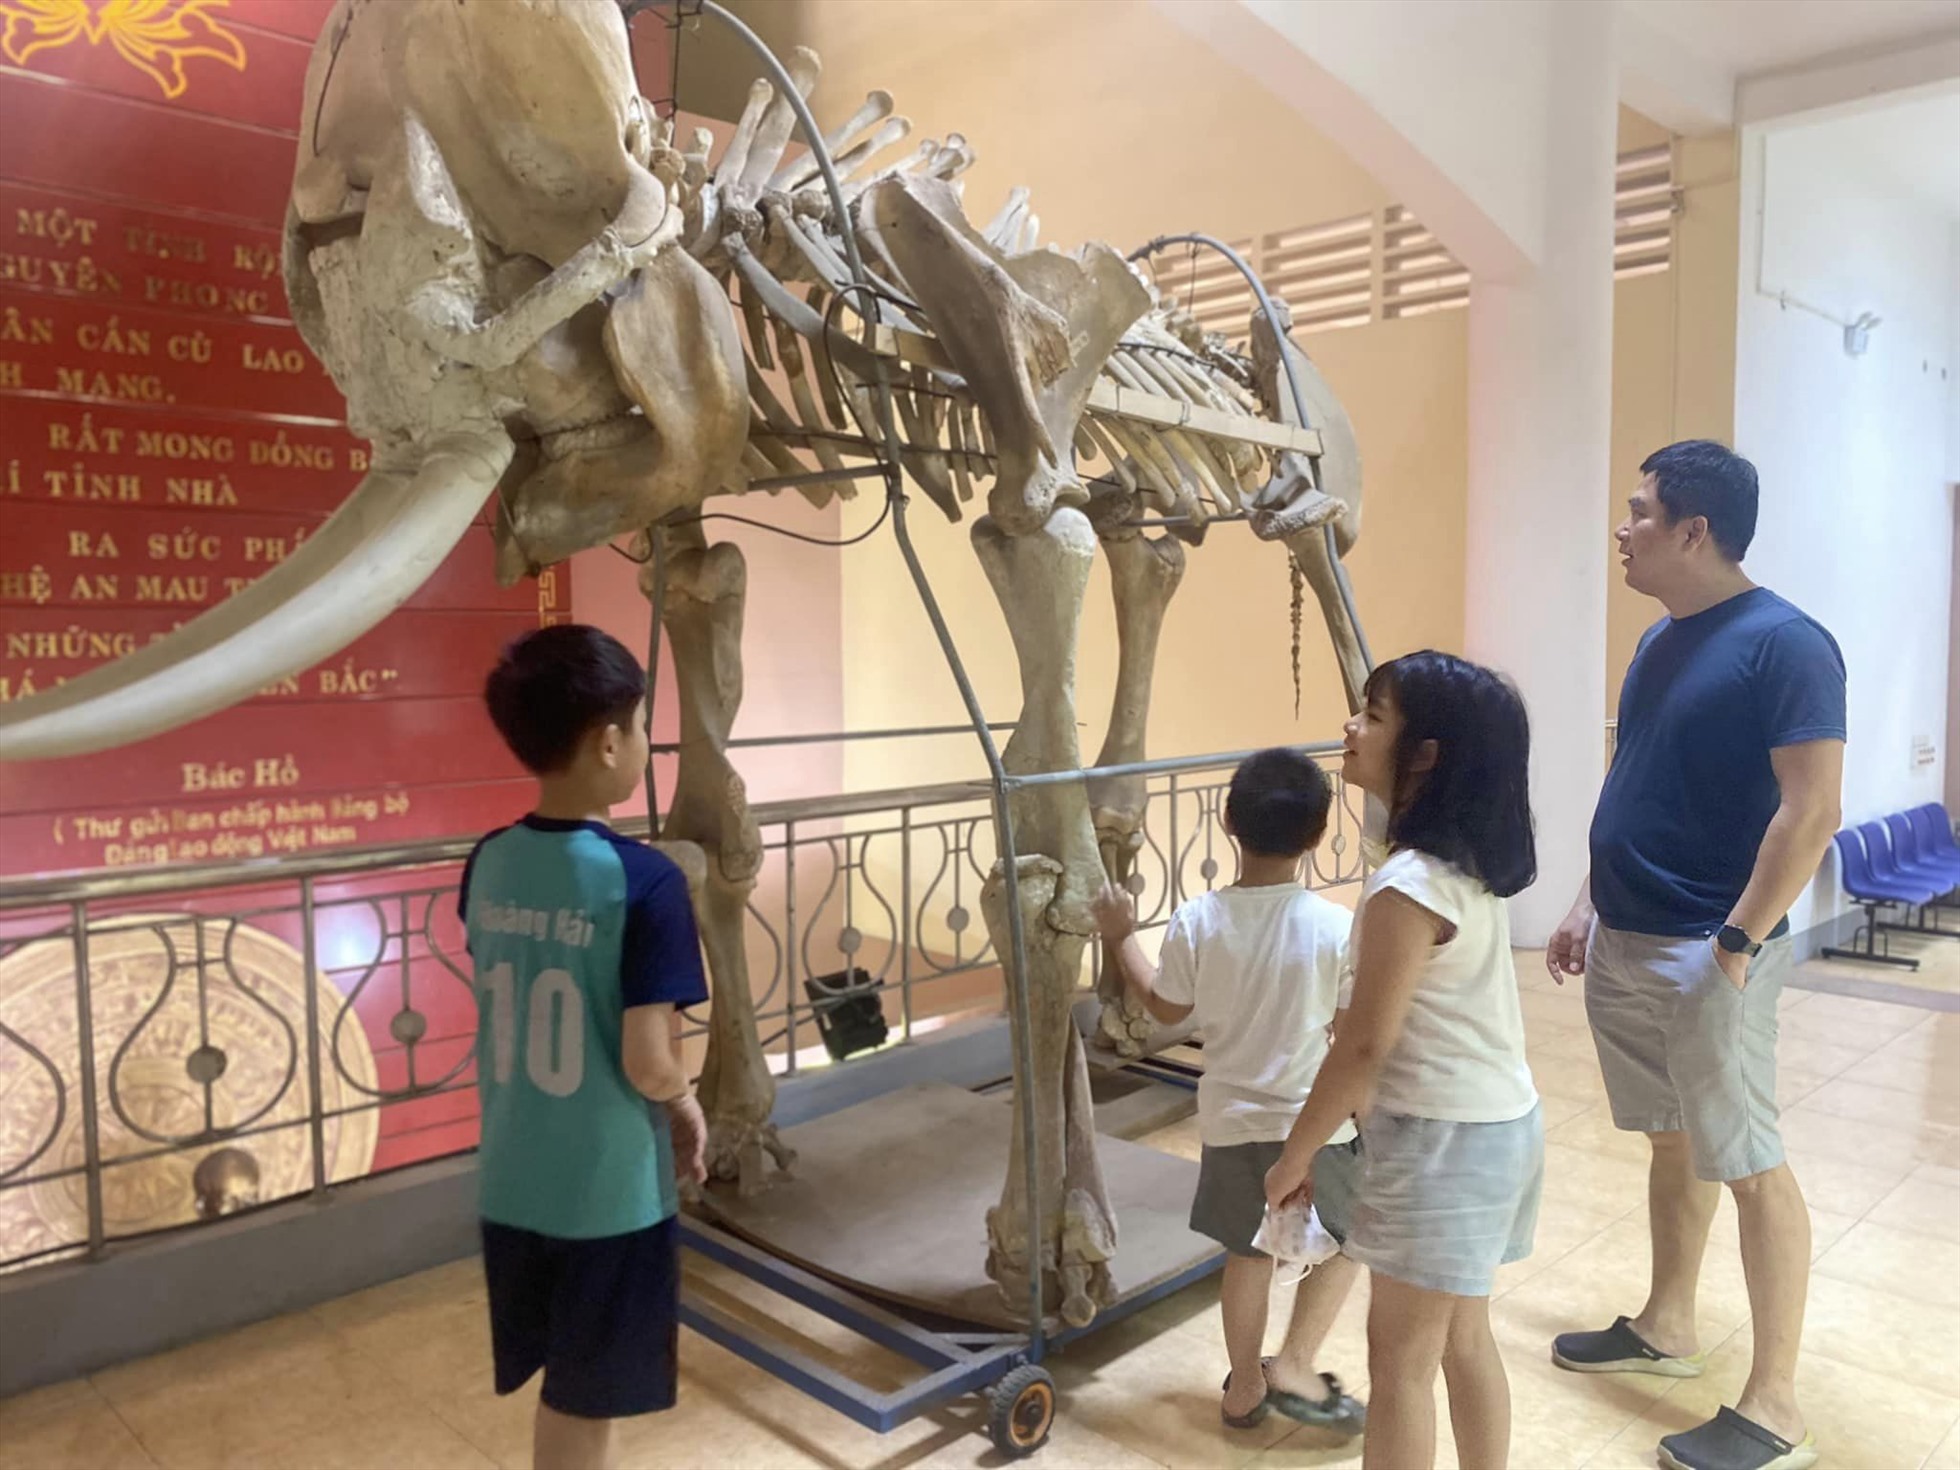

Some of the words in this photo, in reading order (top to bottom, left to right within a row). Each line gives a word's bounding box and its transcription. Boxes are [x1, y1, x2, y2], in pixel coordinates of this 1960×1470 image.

[17, 207, 97, 248] MỘT
[242, 343, 305, 374] LAO
[136, 431, 235, 462] MONG
[166, 472, 239, 506] NHÀ
[68, 530, 119, 558] RA
[71, 574, 119, 600] AN
[136, 575, 208, 601] MAU
[182, 761, 246, 792] Bác
[311, 825, 357, 847] Nam
[479, 961, 585, 1097] 10
